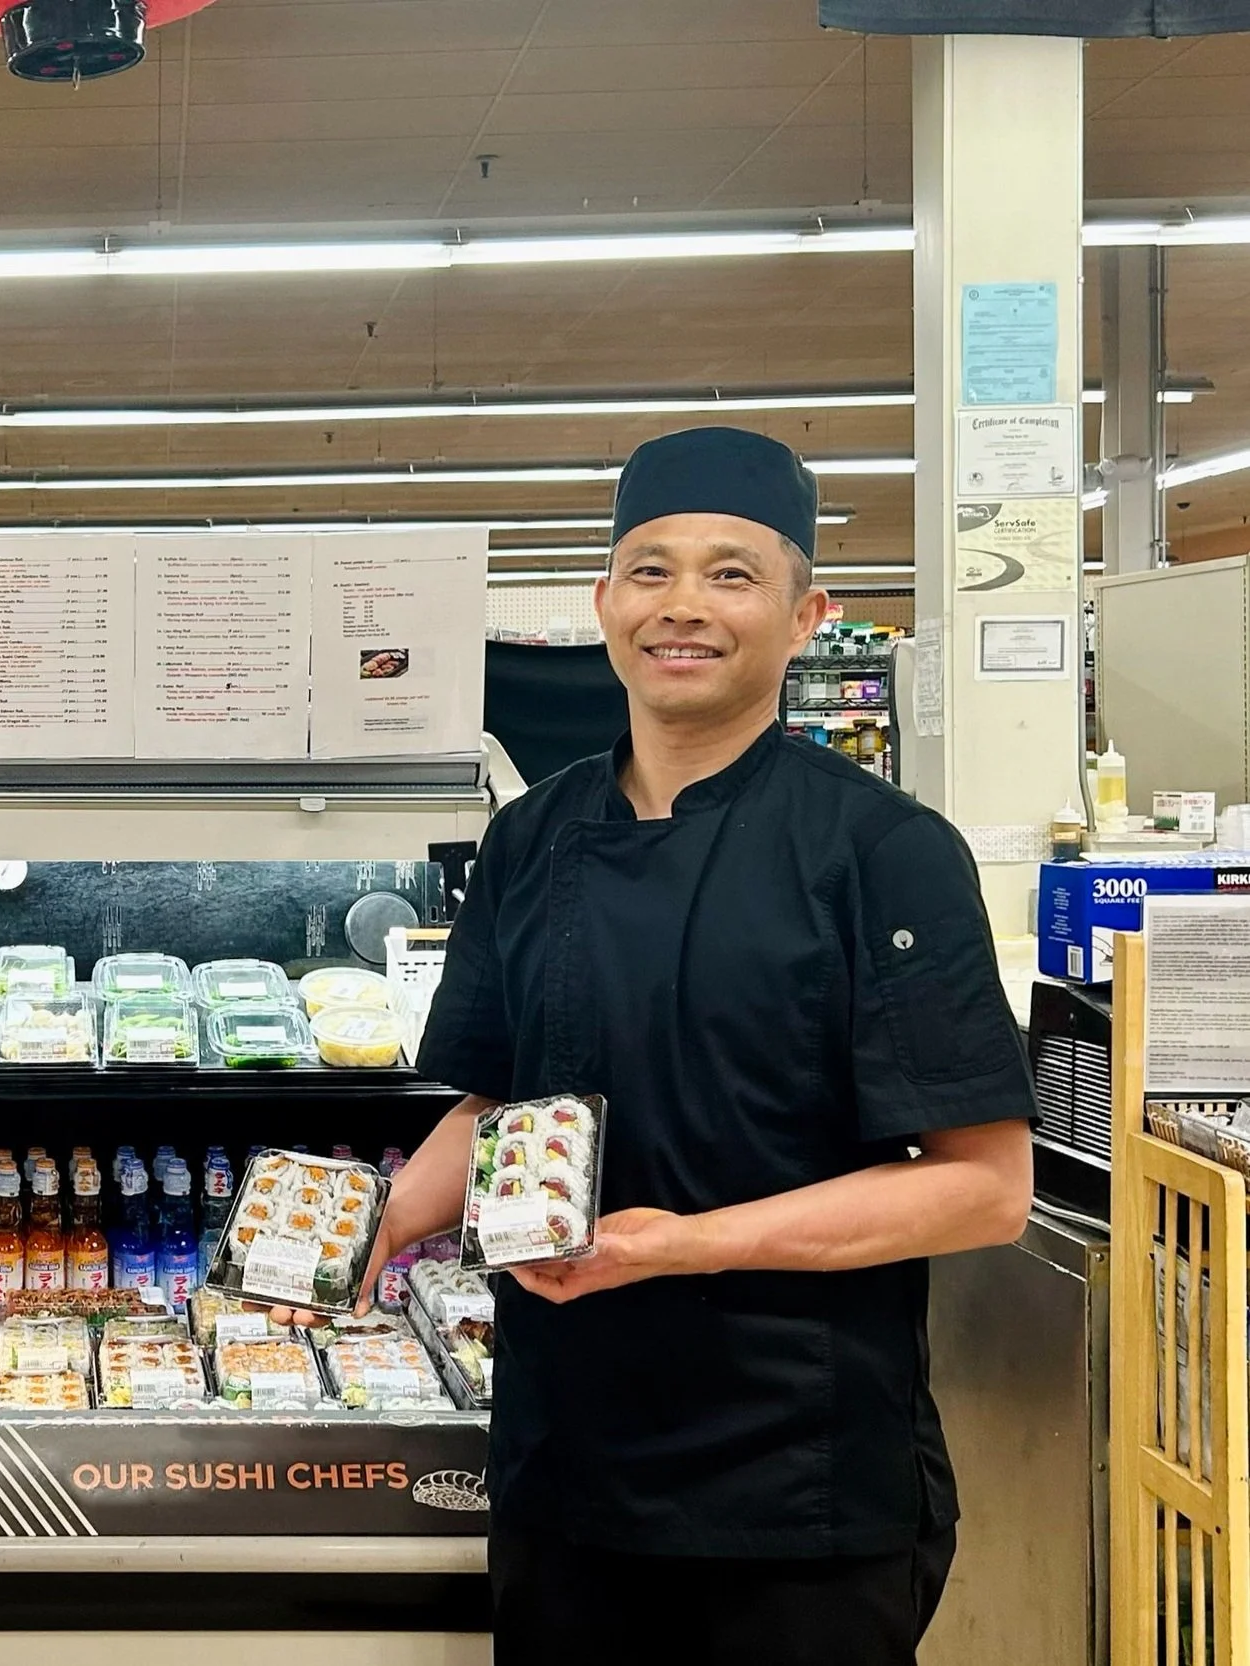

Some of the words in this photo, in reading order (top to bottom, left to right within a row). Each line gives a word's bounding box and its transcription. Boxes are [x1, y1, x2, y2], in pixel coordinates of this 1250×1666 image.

[972, 417, 1008, 430] Certificate
[1010, 417, 1017, 425] of
[1018, 417, 1060, 429] Completion
[994, 519, 1036, 527] ServSafe
[1093, 878, 1147, 897] 3000
[1217, 874, 1250, 885] KIRK
[173, 1276, 188, 1304] ラムネ
[71, 1462, 154, 1490] OUR
[165, 1462, 275, 1490] SUSHI
[286, 1462, 409, 1490] CHEFS
